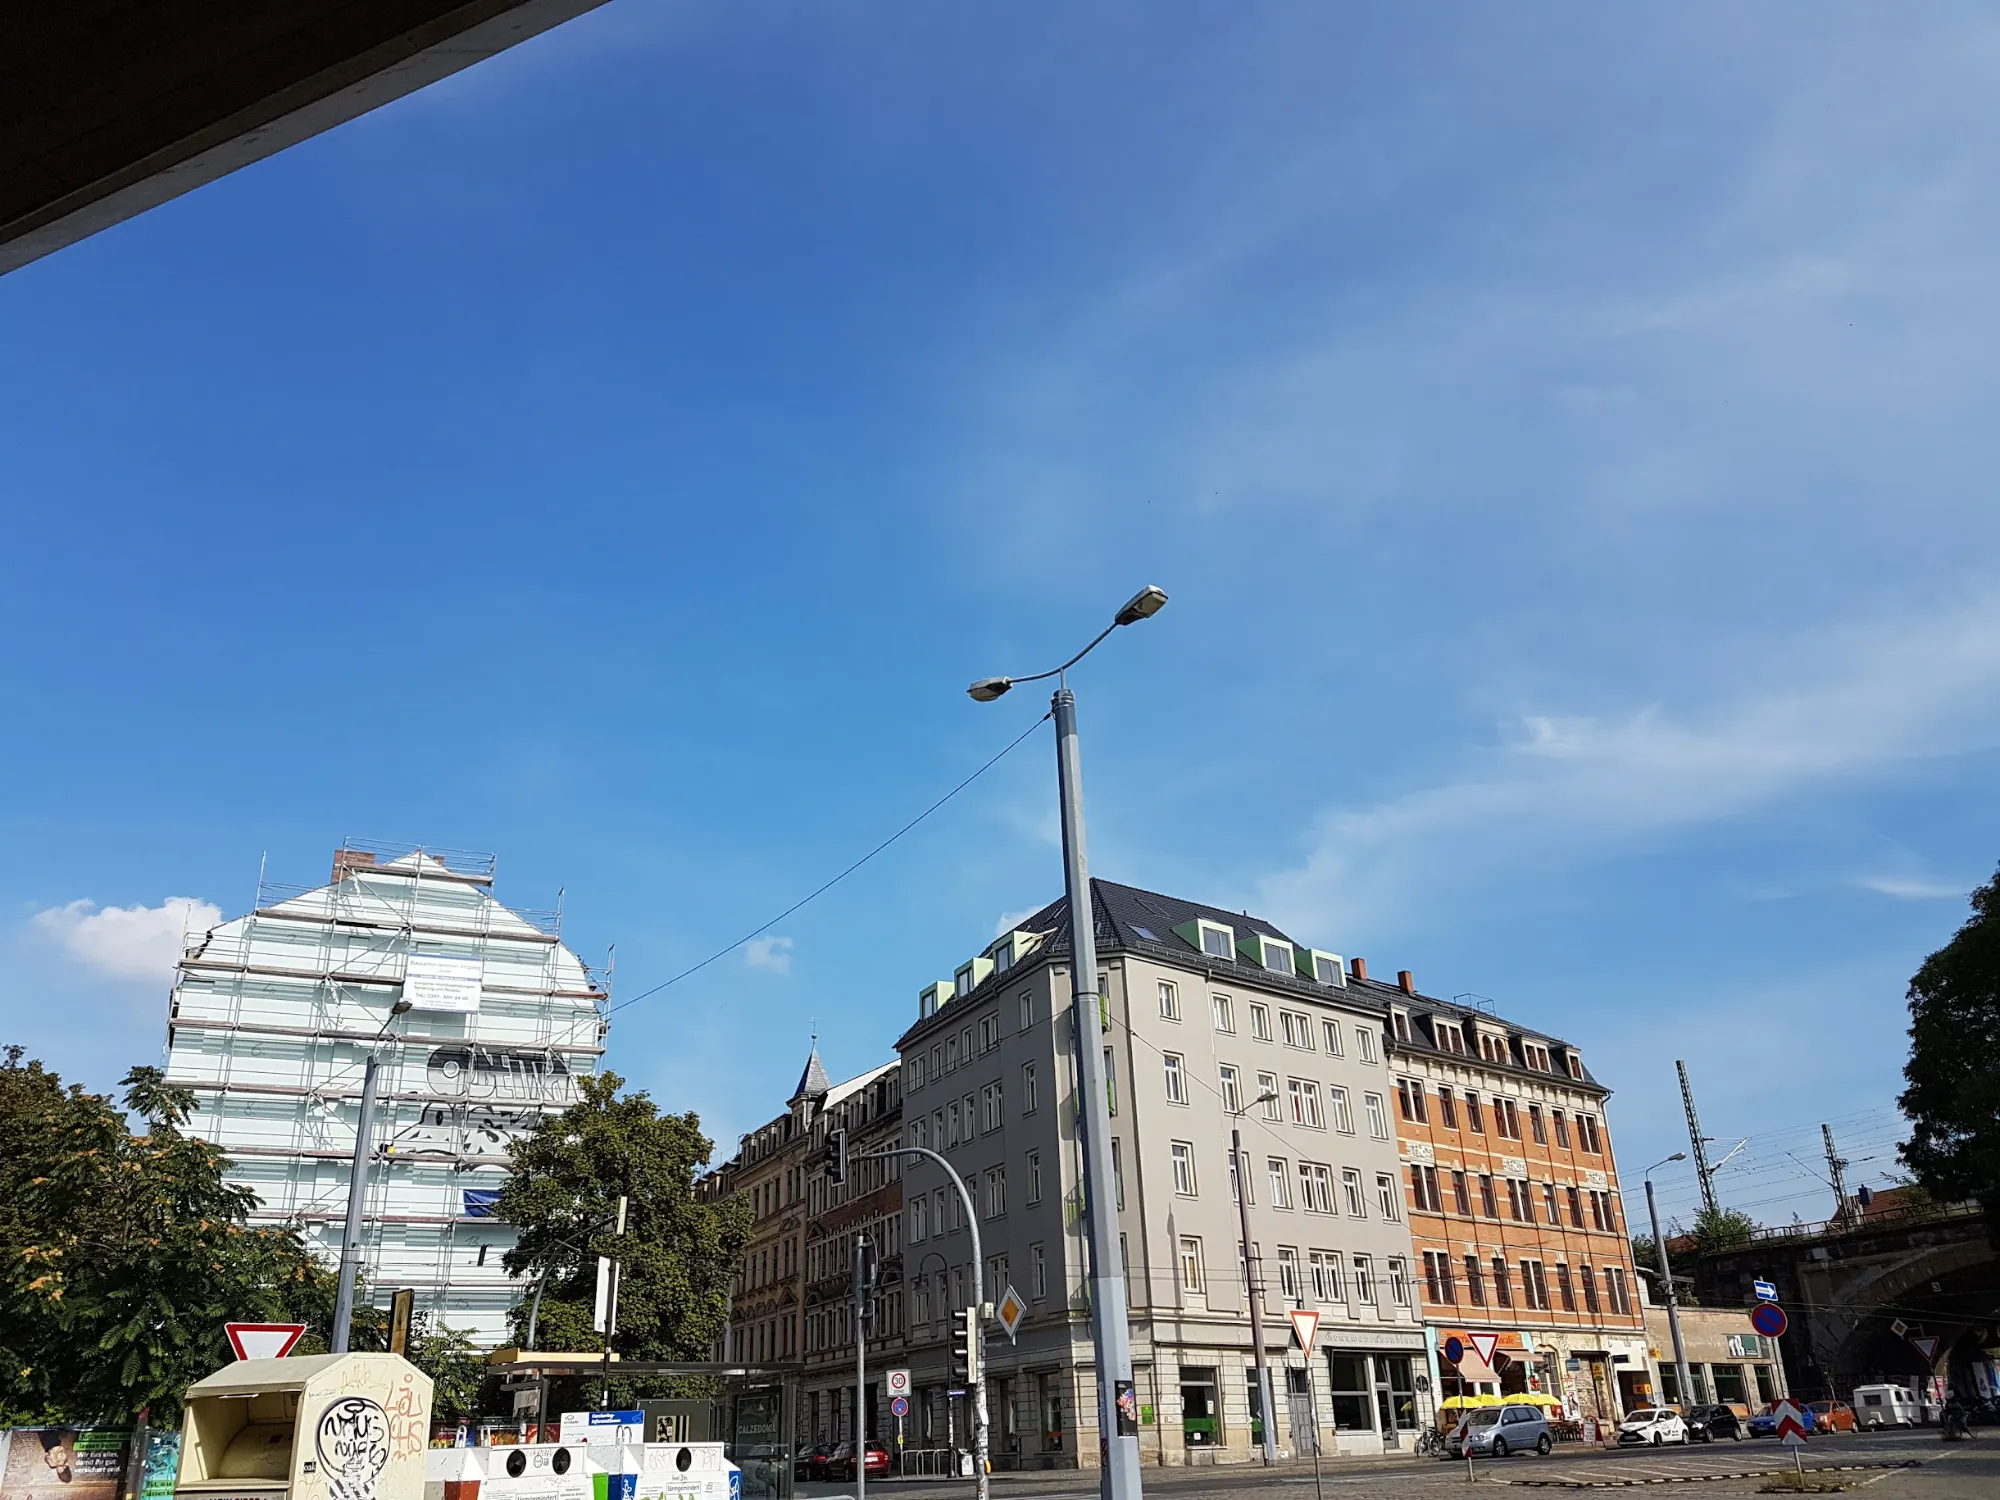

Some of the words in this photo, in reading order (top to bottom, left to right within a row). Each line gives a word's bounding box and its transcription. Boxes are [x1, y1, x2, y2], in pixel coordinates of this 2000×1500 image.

[894, 1377, 903, 1385] 30
[738, 1423, 777, 1435] CALZEDONIA
[105, 1459, 116, 1467] gut
